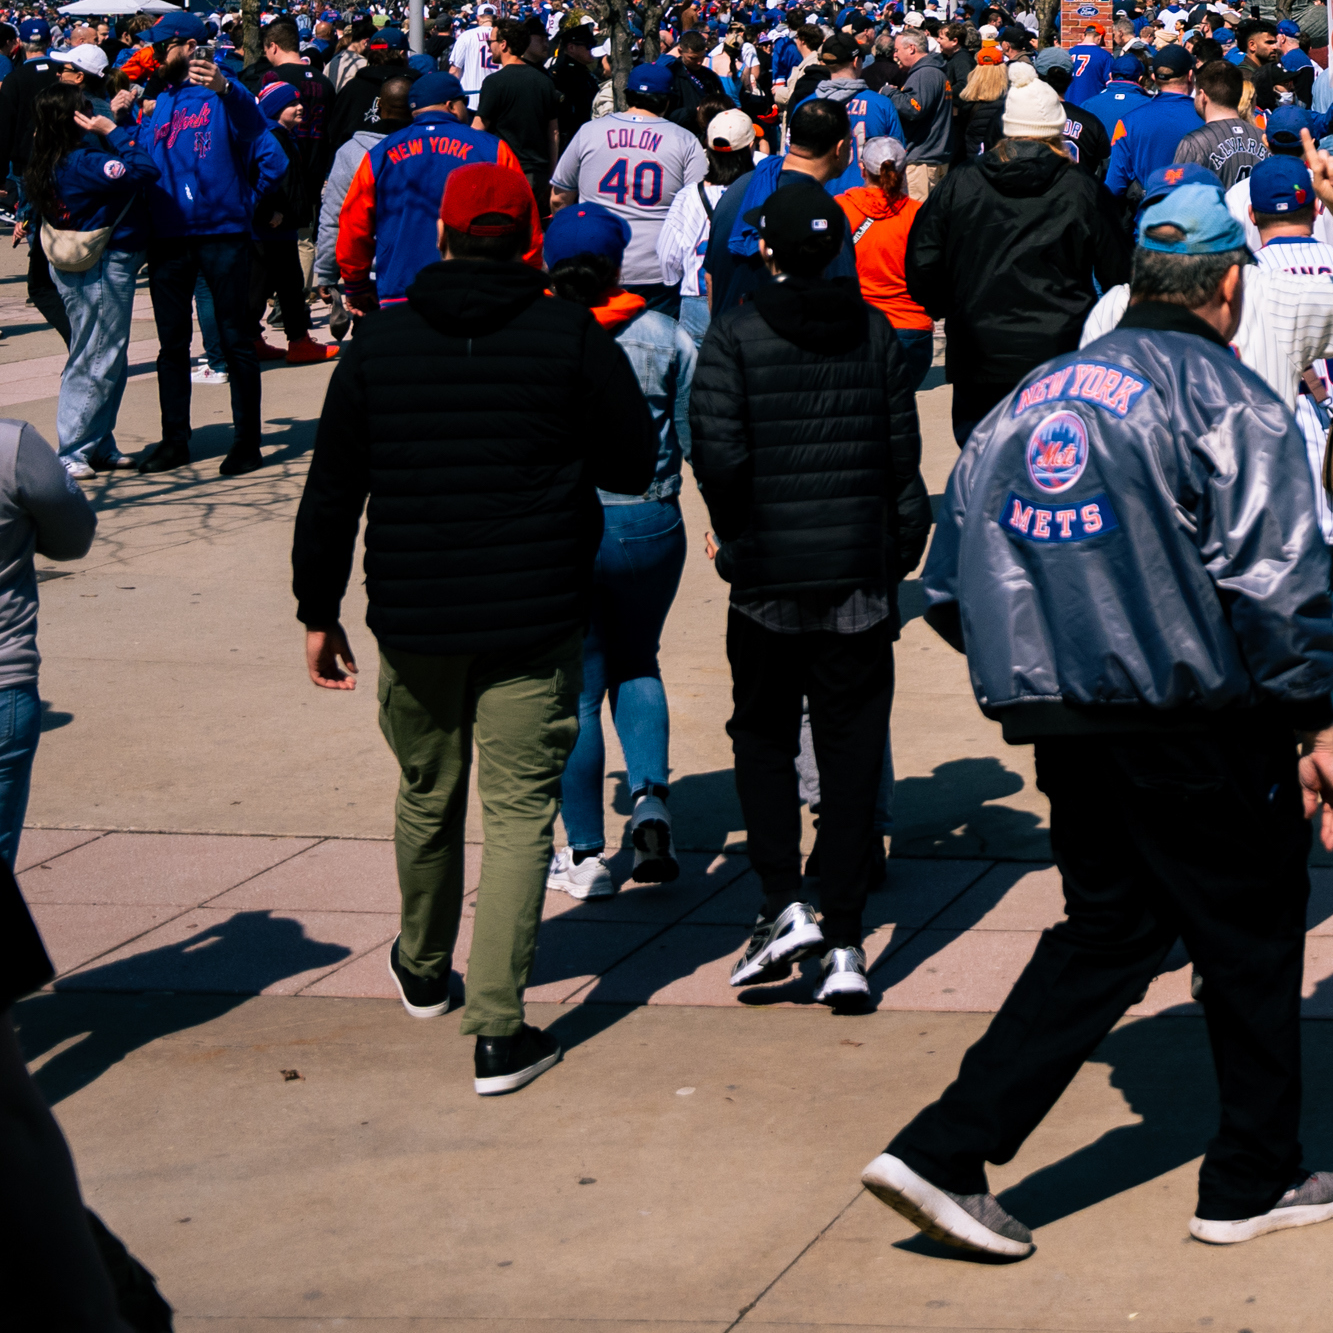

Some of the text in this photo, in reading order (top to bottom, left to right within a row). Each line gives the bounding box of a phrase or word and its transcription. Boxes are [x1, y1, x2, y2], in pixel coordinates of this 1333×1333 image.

[476, 32, 491, 43] LIN
[479, 44, 500, 70] 12
[387, 136, 474, 164] NEW YORK
[606, 127, 663, 153] COLÓN
[1209, 137, 1272, 170] ALVARE
[597, 157, 664, 207] 40
[1014, 364, 1144, 414] NEW YORK
[1036, 441, 1078, 467] Mets
[1009, 499, 1104, 538] METS
